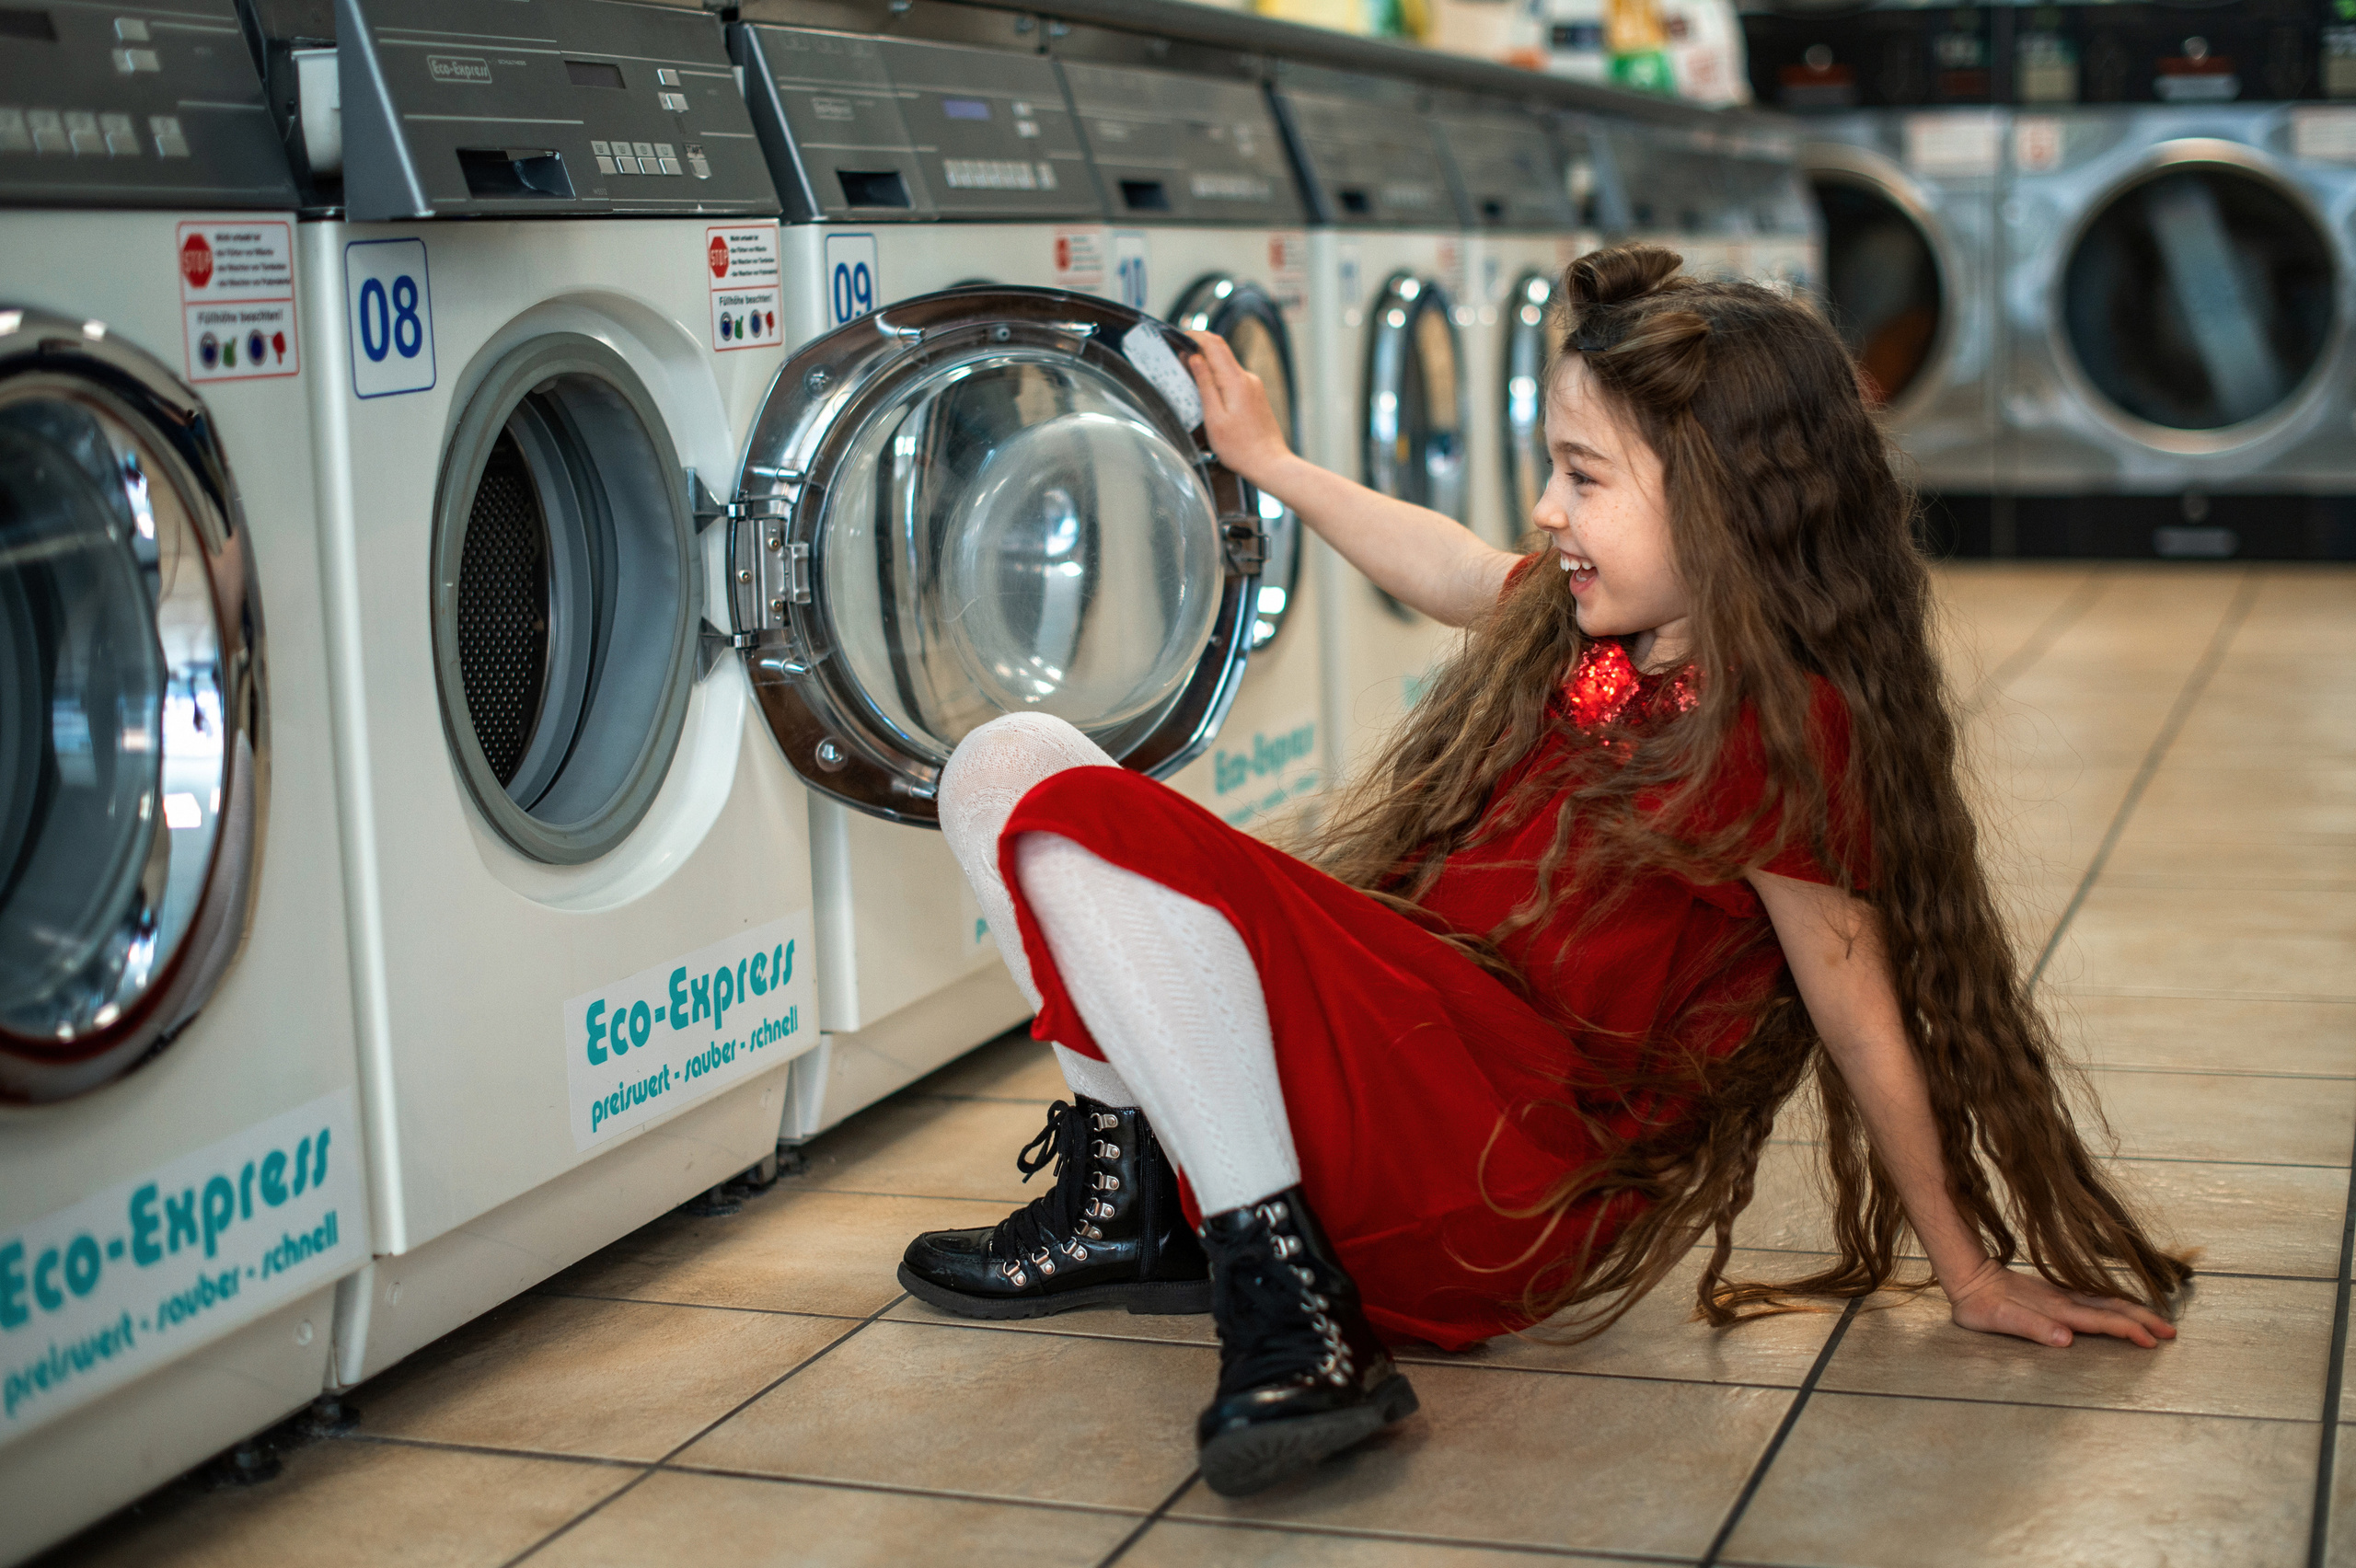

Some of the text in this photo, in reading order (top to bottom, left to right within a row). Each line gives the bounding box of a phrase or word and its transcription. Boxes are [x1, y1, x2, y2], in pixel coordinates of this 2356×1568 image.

[710, 248, 729, 267] STOP
[719, 293, 773, 306] Füllhöhe beachten!
[834, 261, 872, 324] 09
[360, 275, 423, 363] 08
[586, 939, 795, 1066] Eco-Express
[592, 1064, 670, 1133] preiswert
[685, 1039, 736, 1083] sauber
[749, 1004, 798, 1053] schnell
[0, 1127, 331, 1330] Eco-Express
[3, 1310, 135, 1419] preiswert
[156, 1266, 240, 1332] sauber
[261, 1209, 339, 1280] schnell
